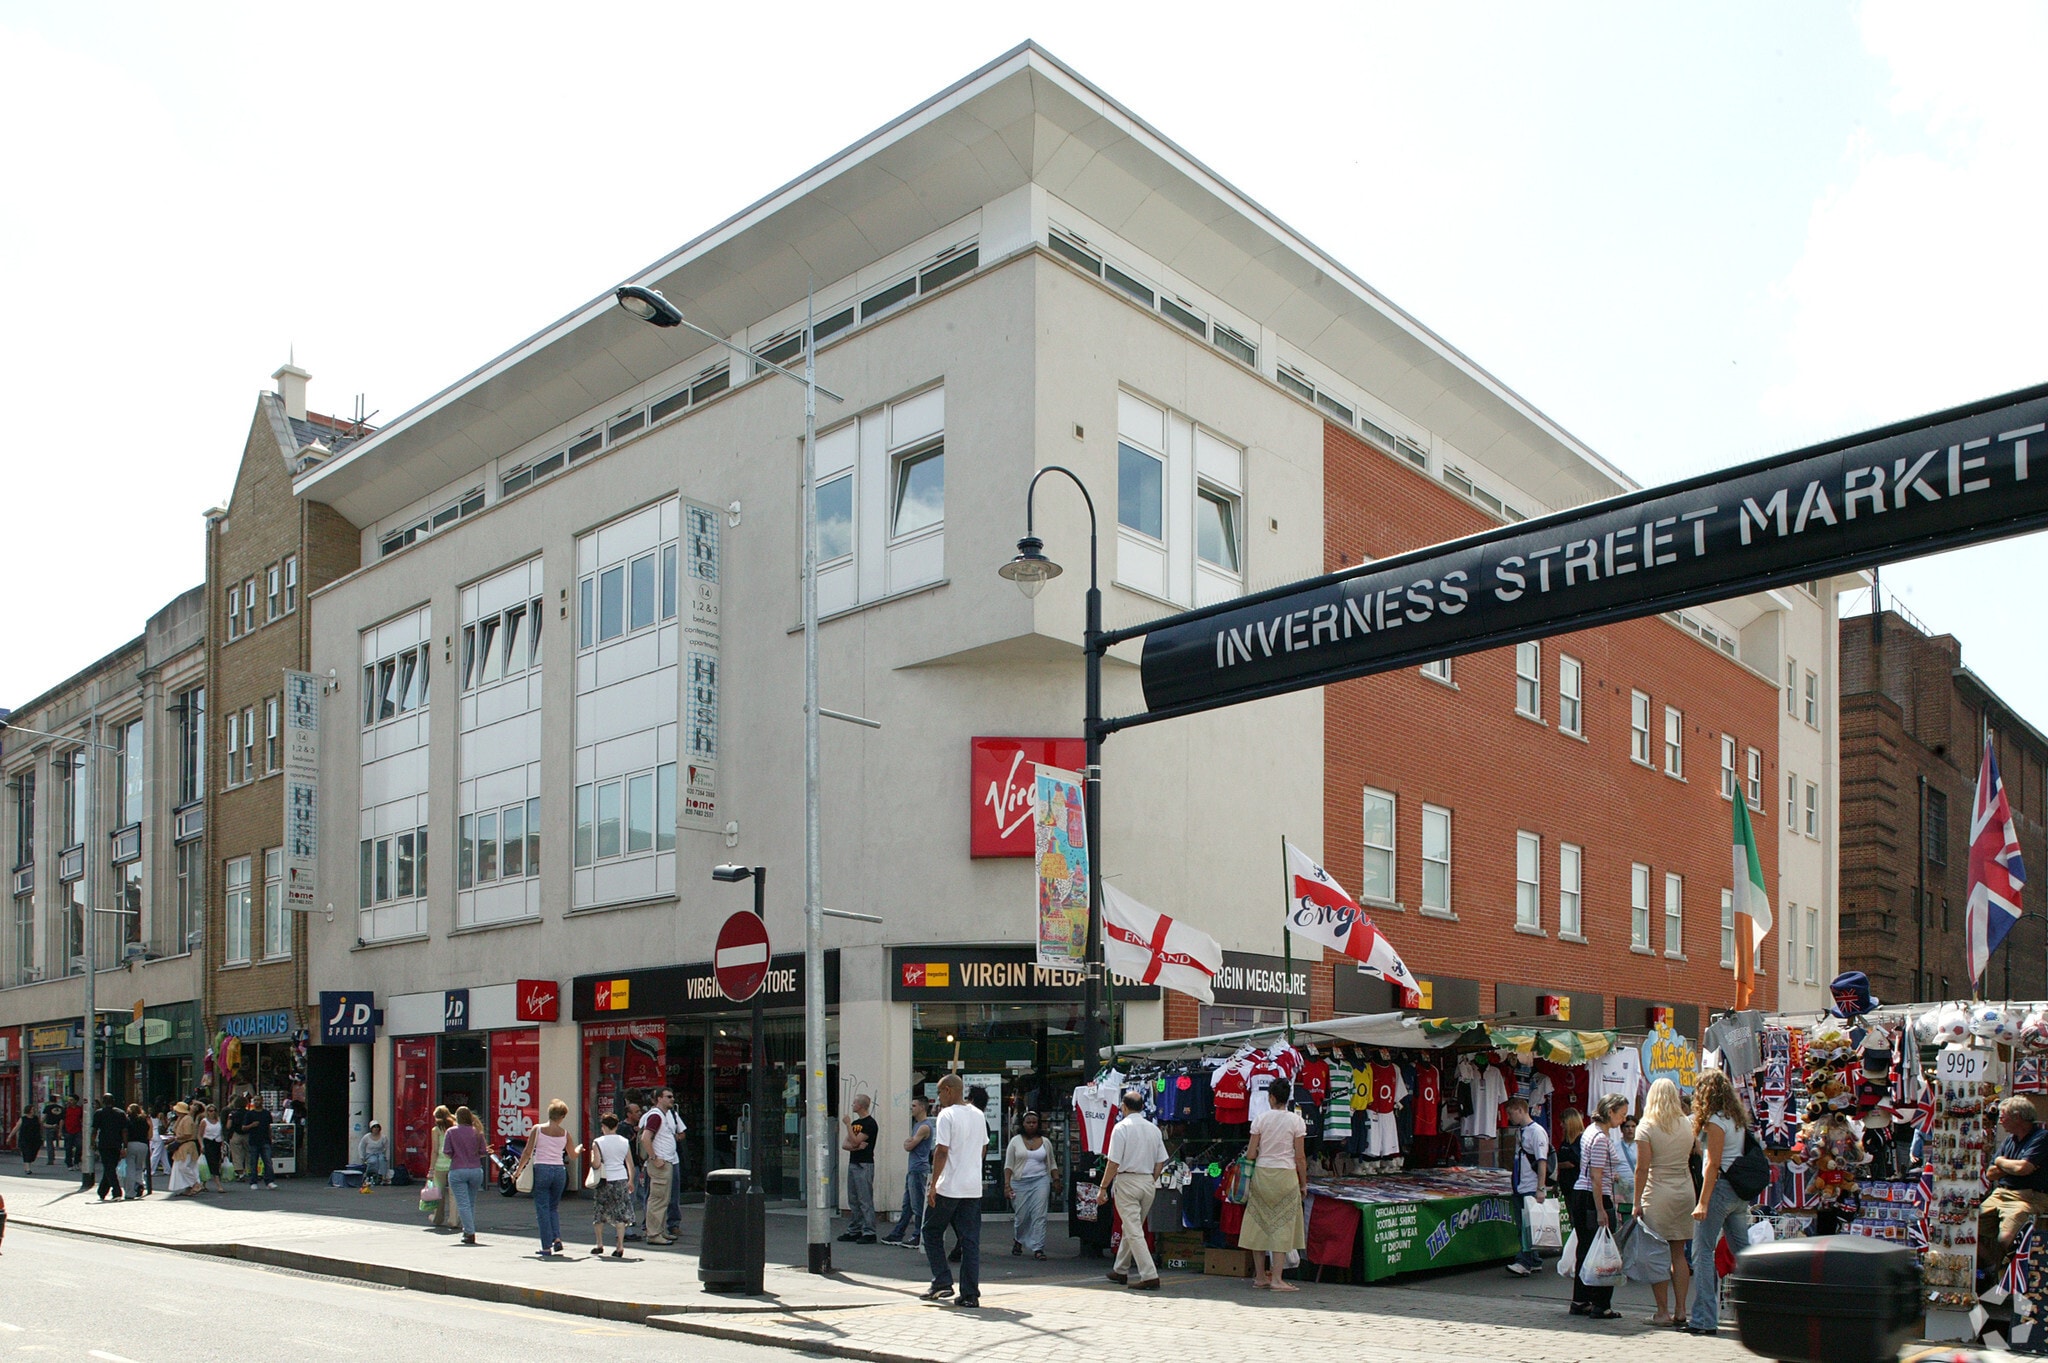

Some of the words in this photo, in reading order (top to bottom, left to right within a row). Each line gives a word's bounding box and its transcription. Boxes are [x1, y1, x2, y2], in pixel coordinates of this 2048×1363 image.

[1216, 570, 1468, 668] INVERNESS
[1494, 506, 1719, 602] STREET
[1740, 423, 2046, 546] MARKET
[700, 587, 710, 597] 14
[706, 604, 712, 613] &
[714, 605, 719, 615] 3
[693, 614, 718, 627] bedroom
[695, 657, 715, 753] Hush
[293, 755, 314, 763] bedroom
[286, 762, 319, 772] contemporary
[686, 797, 715, 810] home
[289, 890, 314, 900] home
[960, 963, 1026, 987] VIRGIN
[1213, 966, 1243, 990] IRGIN
[526, 986, 554, 1015] Virgin
[226, 1012, 289, 1038] AQUARIUS
[446, 1018, 463, 1027] SPORTS
[328, 1026, 368, 1036] SPORTS
[1946, 1053, 1975, 1078] 99p
[499, 1070, 531, 1107] big
[1215, 1090, 1244, 1100] Arsenal
[497, 1110, 533, 1137] sale
[1375, 1206, 1396, 1218] OFFICIAL
[1396, 1204, 1417, 1214] REPLICA
[1399, 1215, 1416, 1226] SHIRTS
[1401, 1227, 1418, 1237] WEAR
[1425, 1219, 1451, 1260] THE
[1450, 1198, 1512, 1238] FOOTBALL
